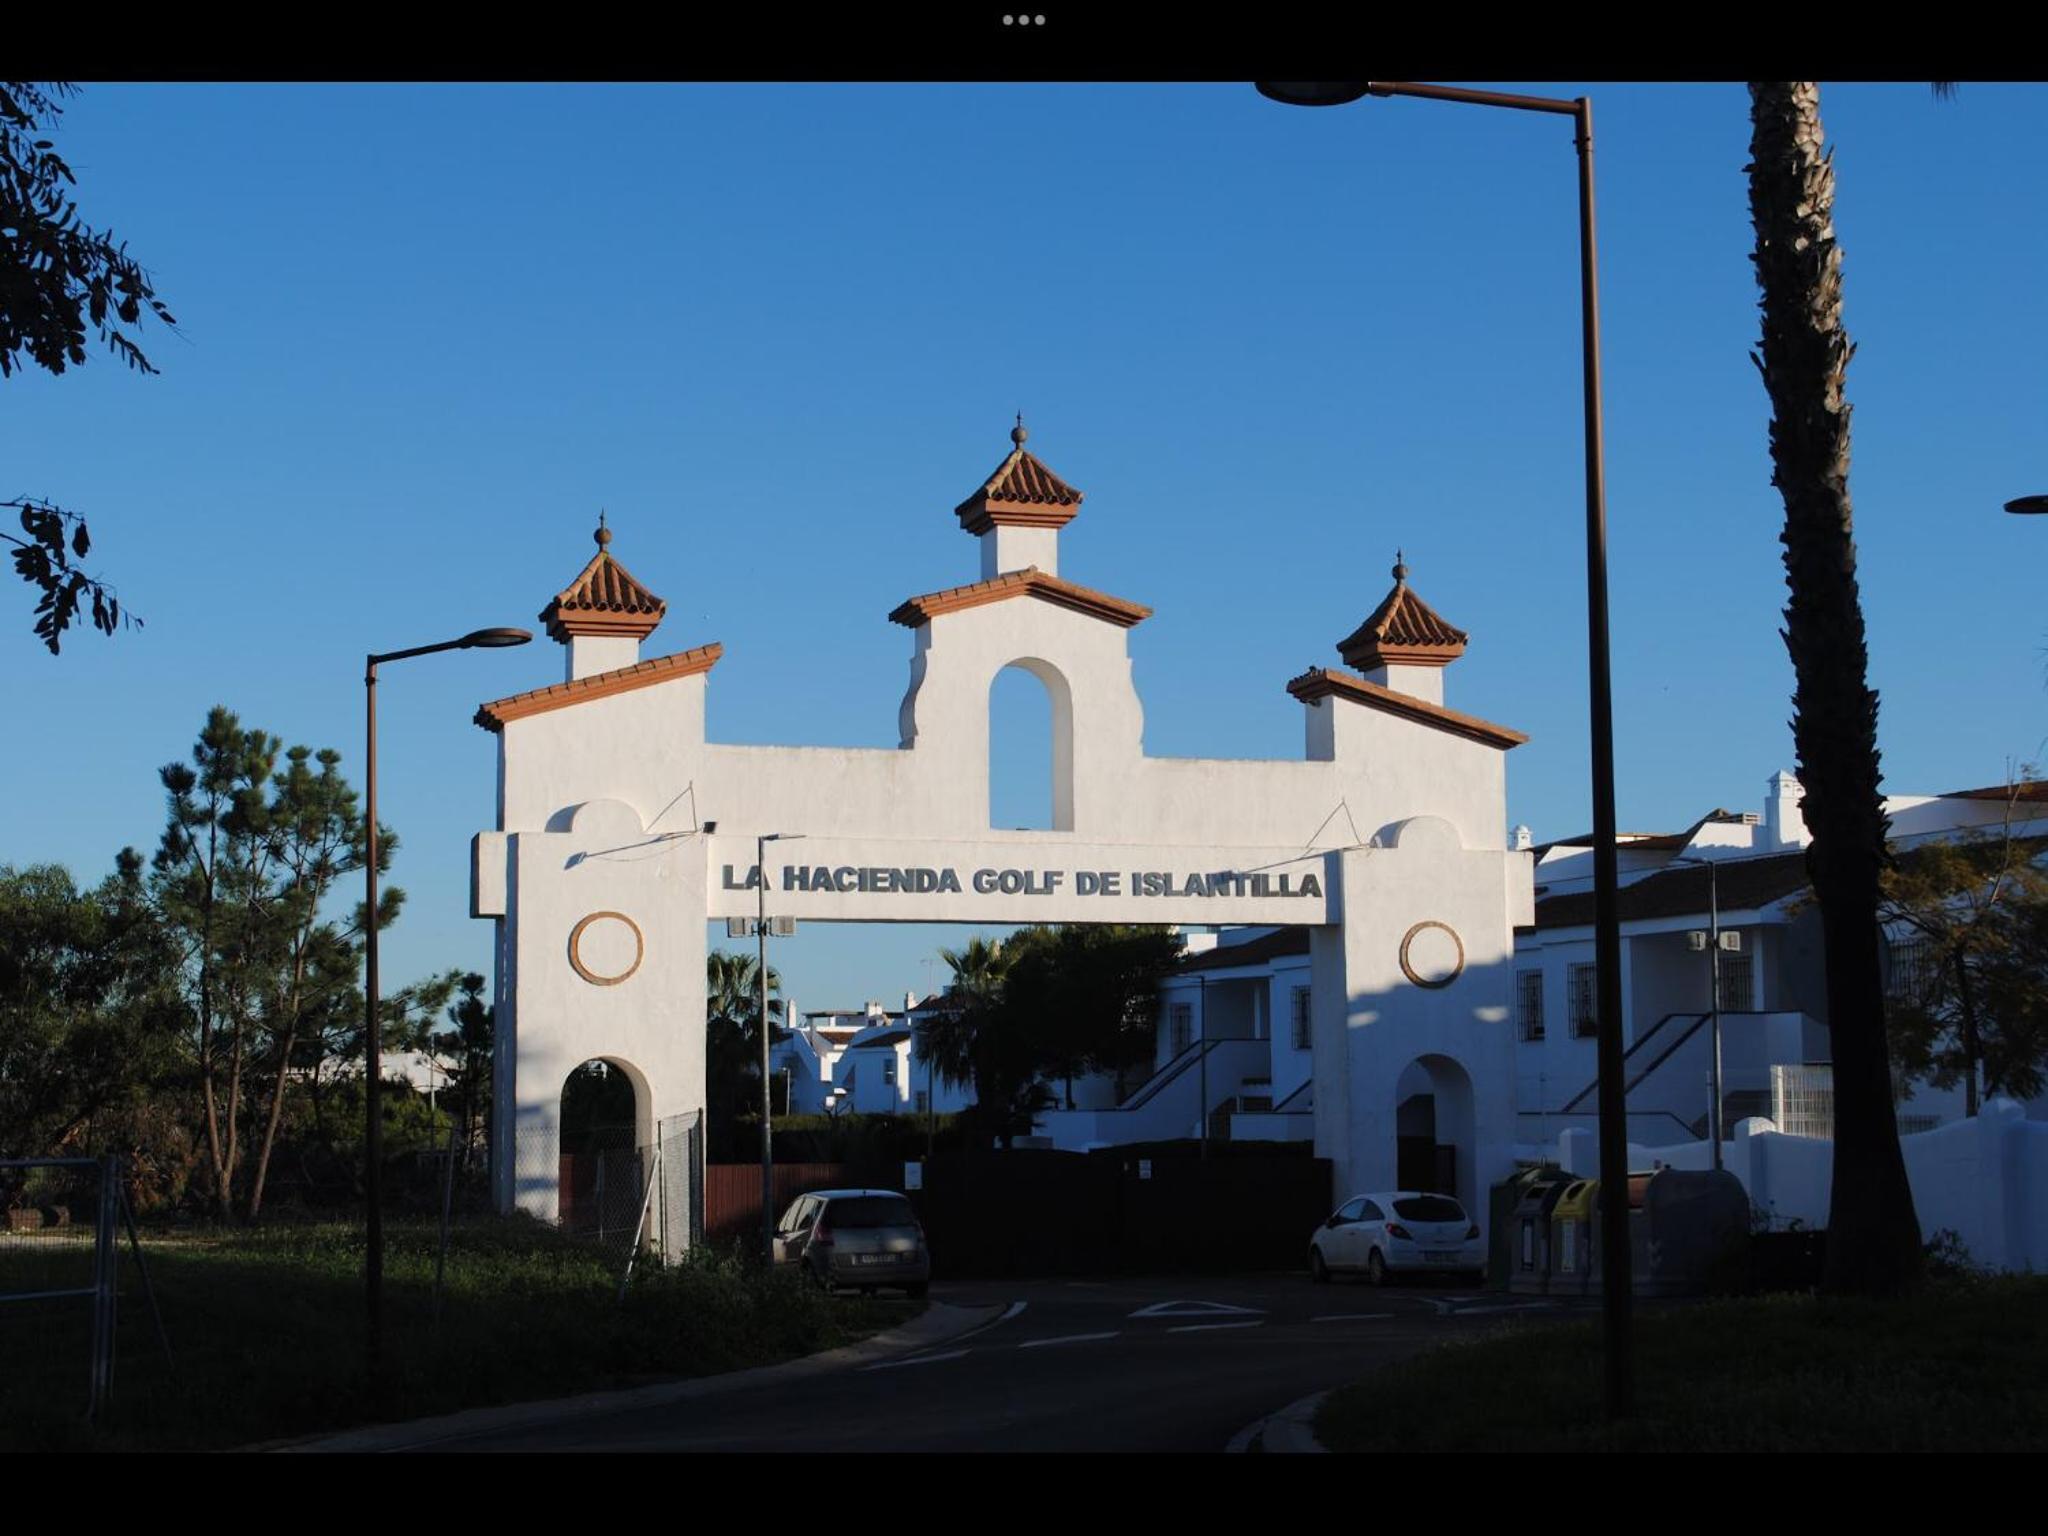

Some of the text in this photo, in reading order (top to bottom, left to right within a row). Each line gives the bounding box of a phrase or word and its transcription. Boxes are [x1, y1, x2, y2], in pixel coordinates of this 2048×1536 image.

[722, 864, 1322, 897] LA HACIENDA GOLF DE ISLANTILLA
